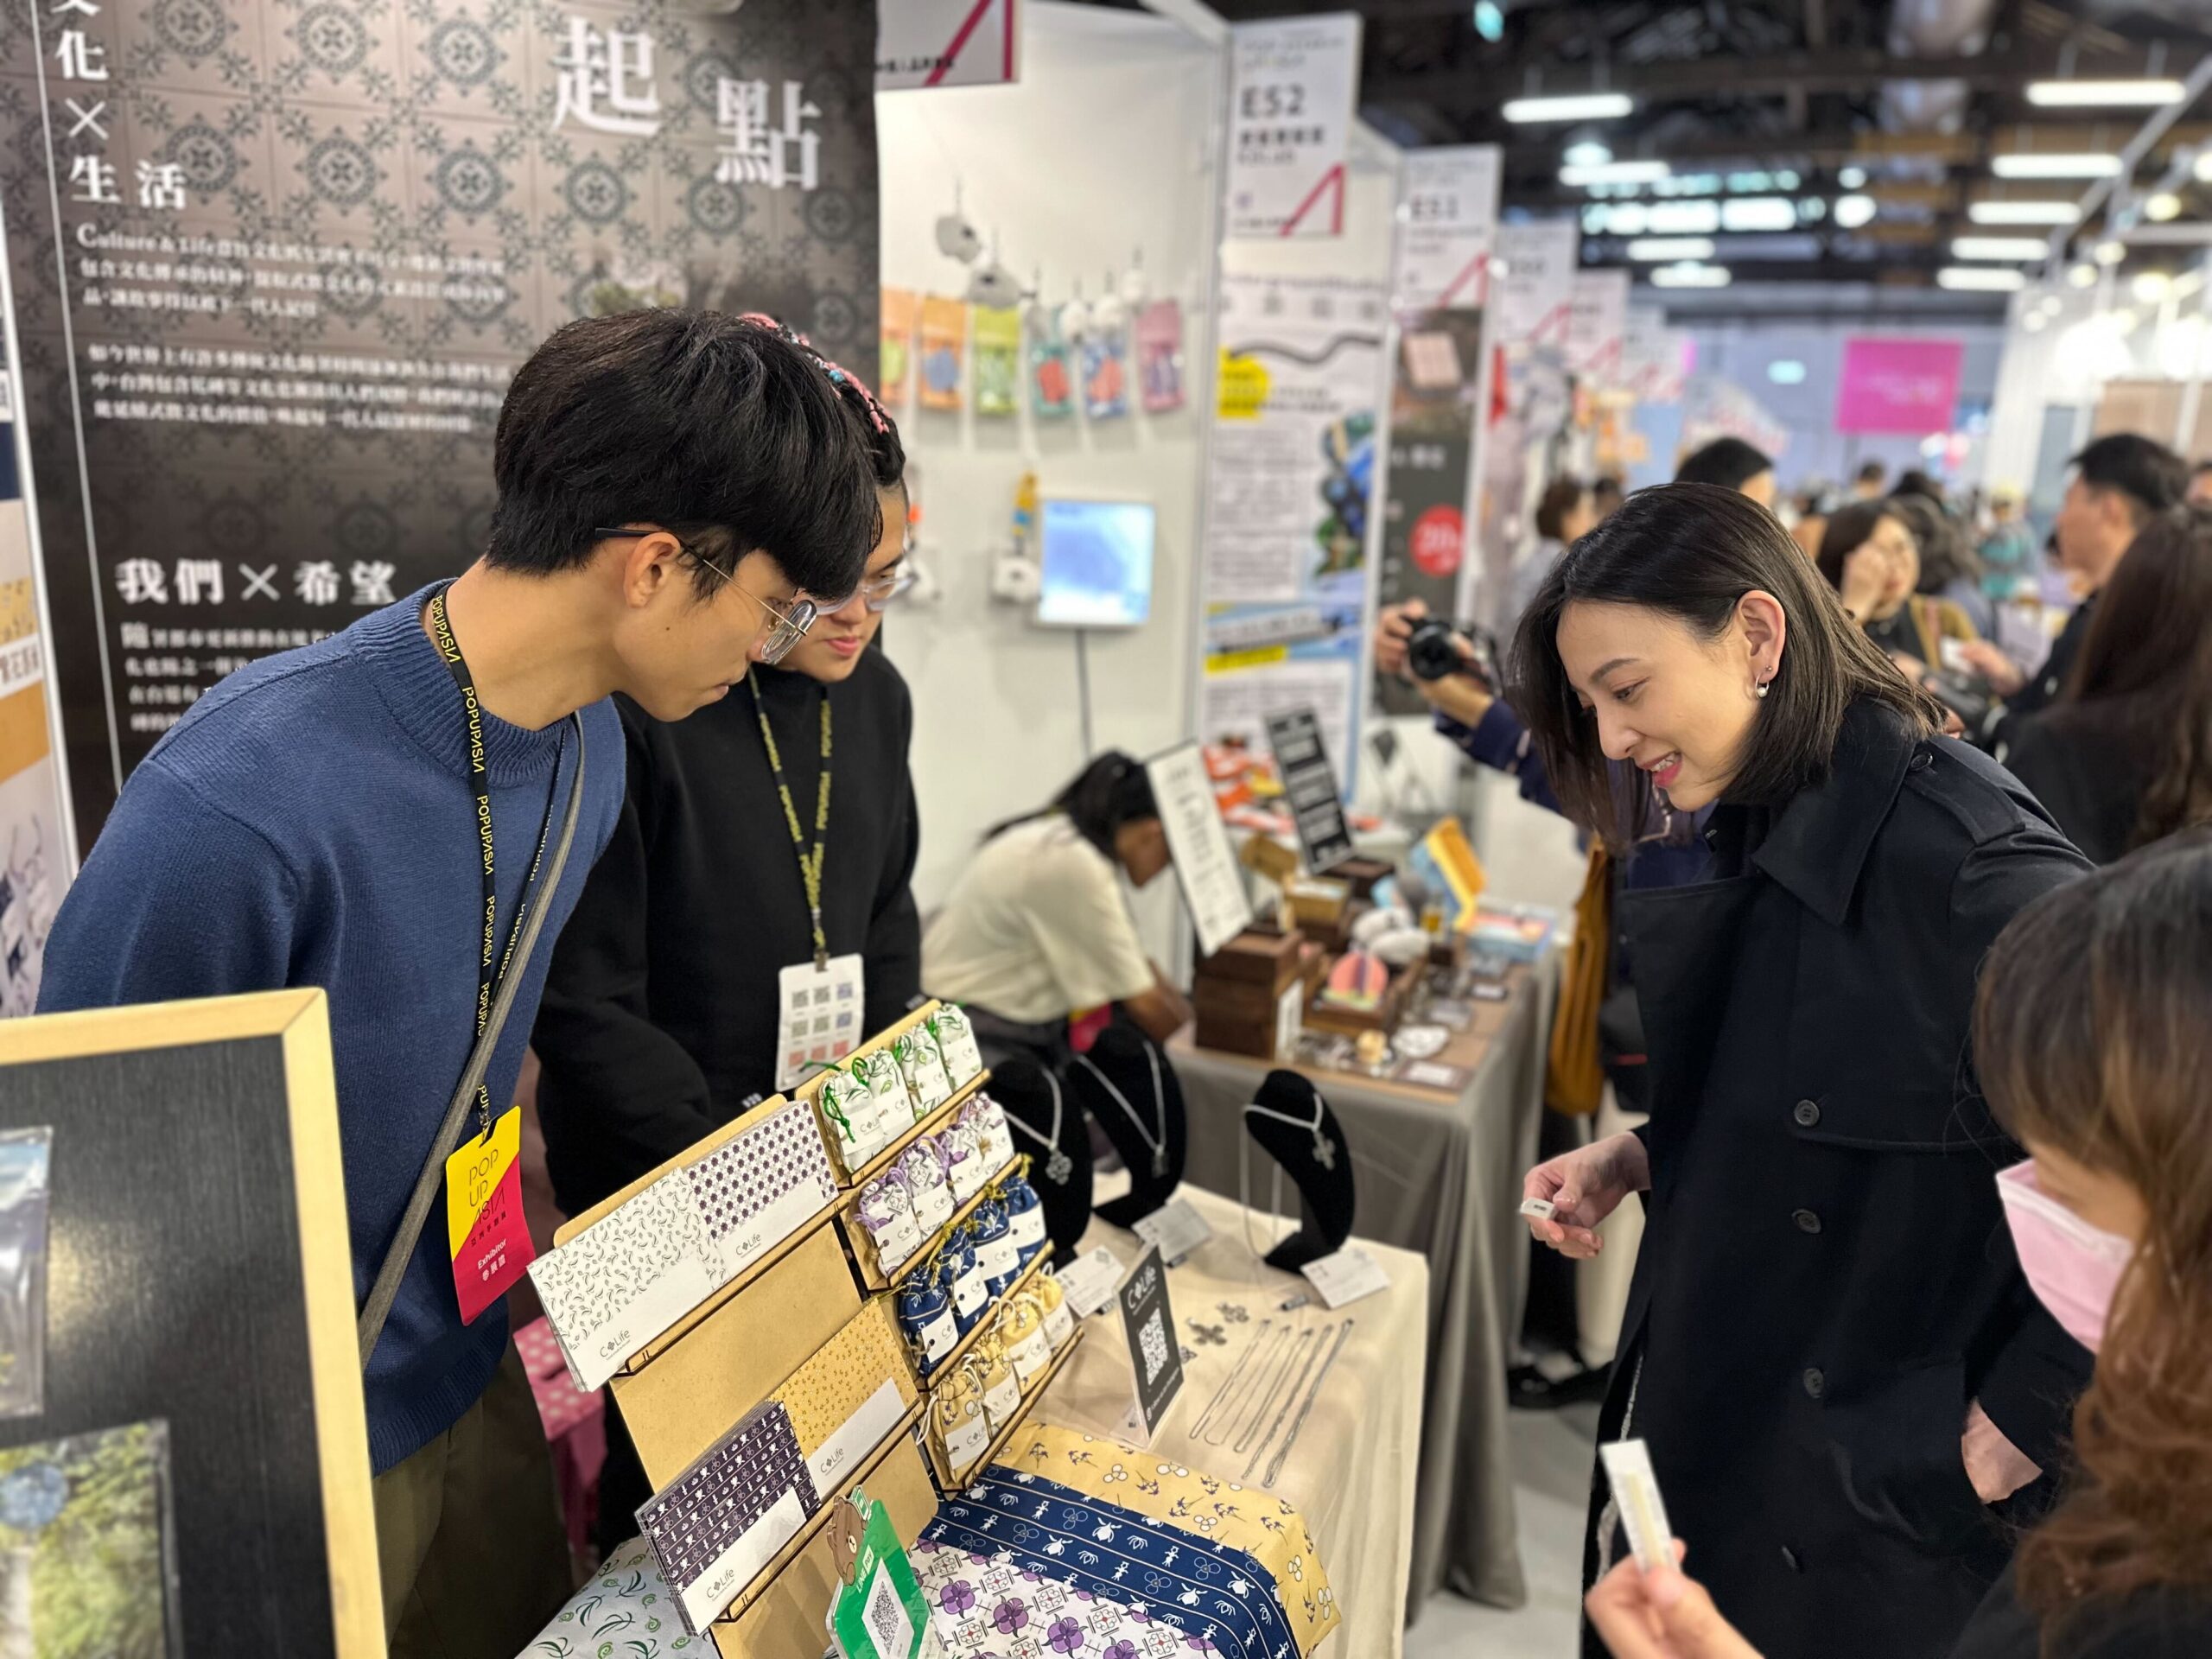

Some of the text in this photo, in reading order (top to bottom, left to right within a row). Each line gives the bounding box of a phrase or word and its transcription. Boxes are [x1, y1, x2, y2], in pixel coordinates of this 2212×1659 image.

[68, 155, 187, 210] 生活
[76, 222, 157, 251] Culture
[433, 594, 461, 664] POPUPASIA
[462, 686, 486, 773] POPUPASIA
[477, 795, 494, 875] POPUPASIA
[483, 895, 496, 967] POPUPASIA
[469, 1148, 499, 1185] POP
[469, 1179, 488, 1207] UP
[474, 1186, 505, 1224] ASIA
[477, 1238, 507, 1270] Exhibitor
